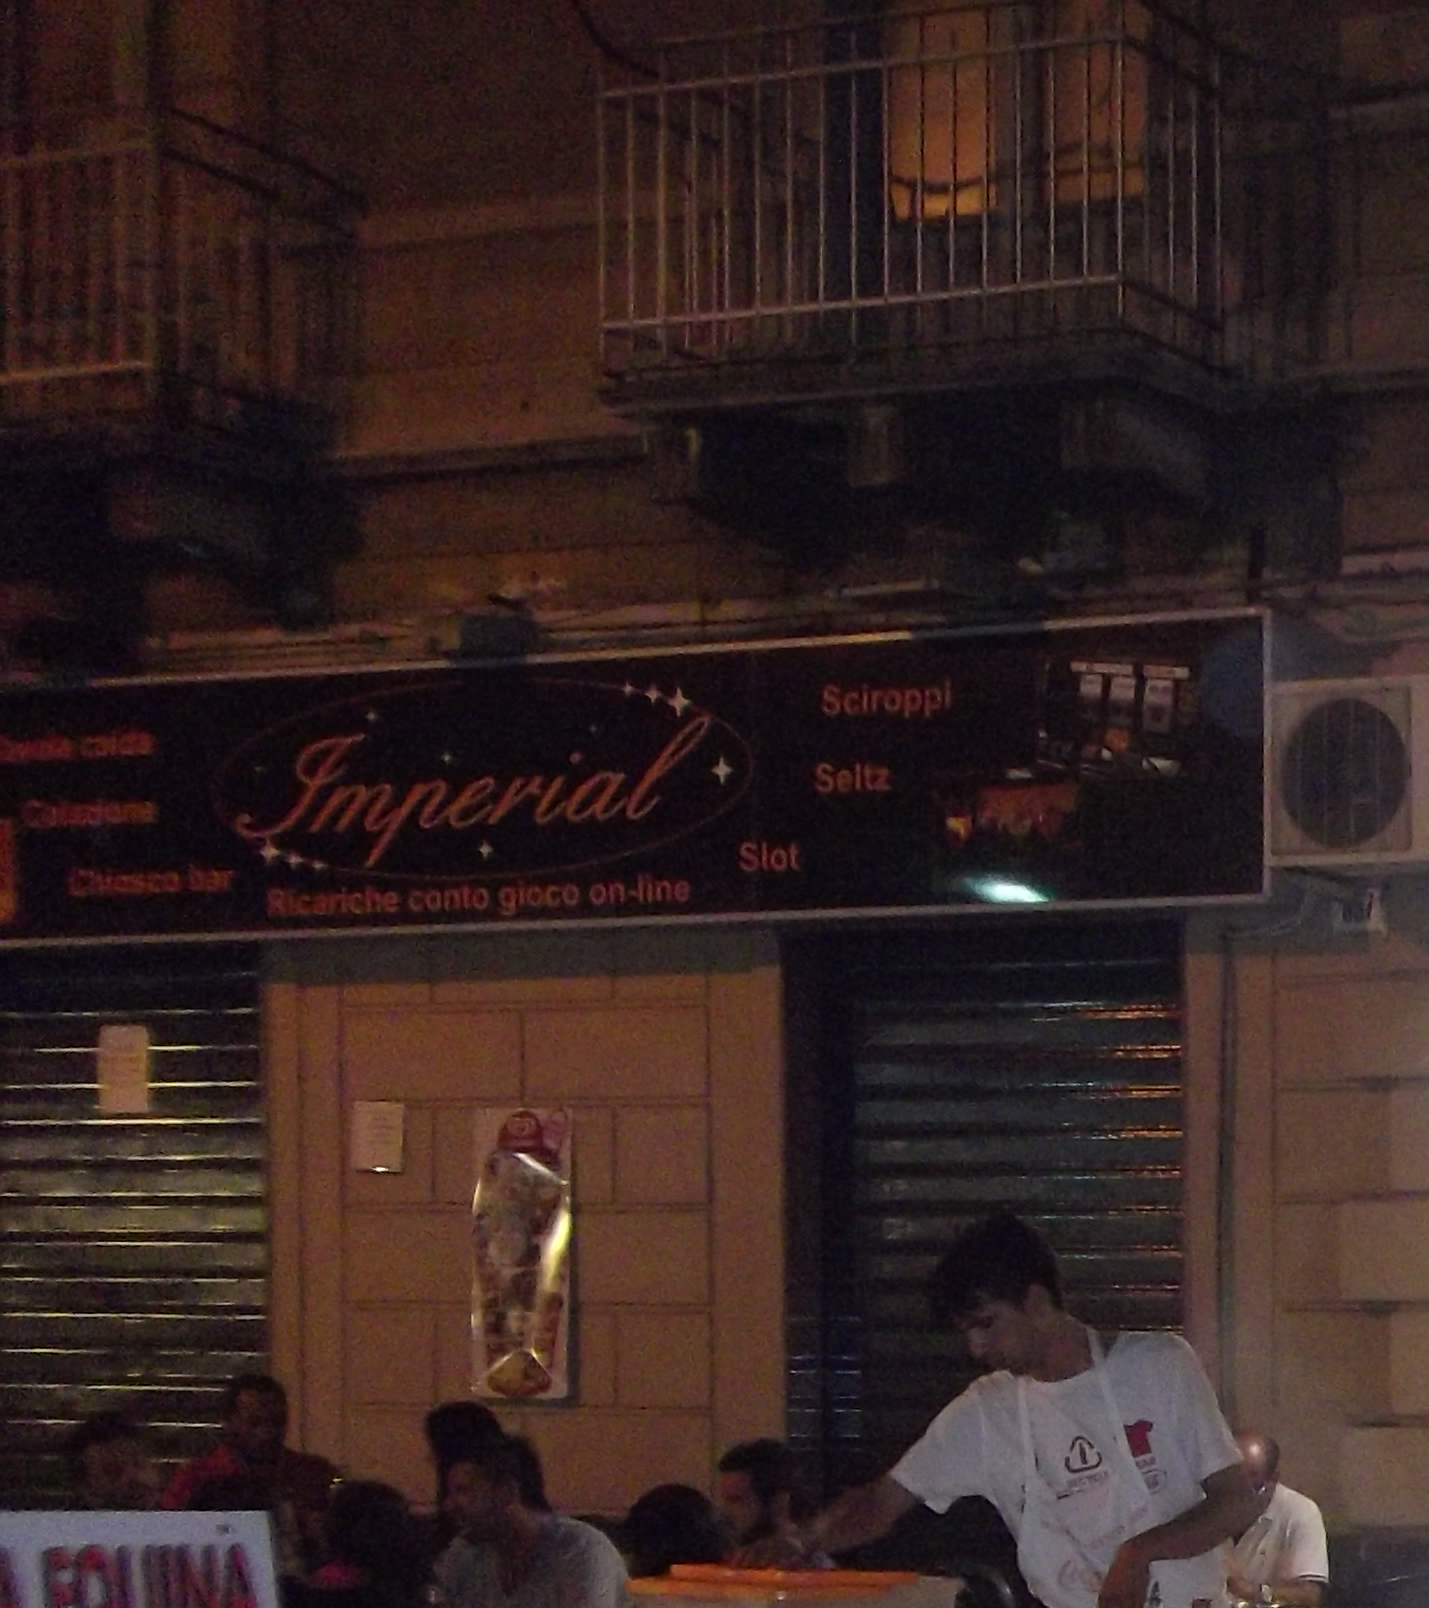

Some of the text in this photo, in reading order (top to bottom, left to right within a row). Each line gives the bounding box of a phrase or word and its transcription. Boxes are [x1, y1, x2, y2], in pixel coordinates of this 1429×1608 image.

[820, 682, 953, 720] Sciroppi
[234, 714, 713, 869] Imperial
[814, 762, 892, 794] Seltz
[738, 841, 802, 873] Slot
[265, 873, 692, 918] Ricariche conto gioco on-line
